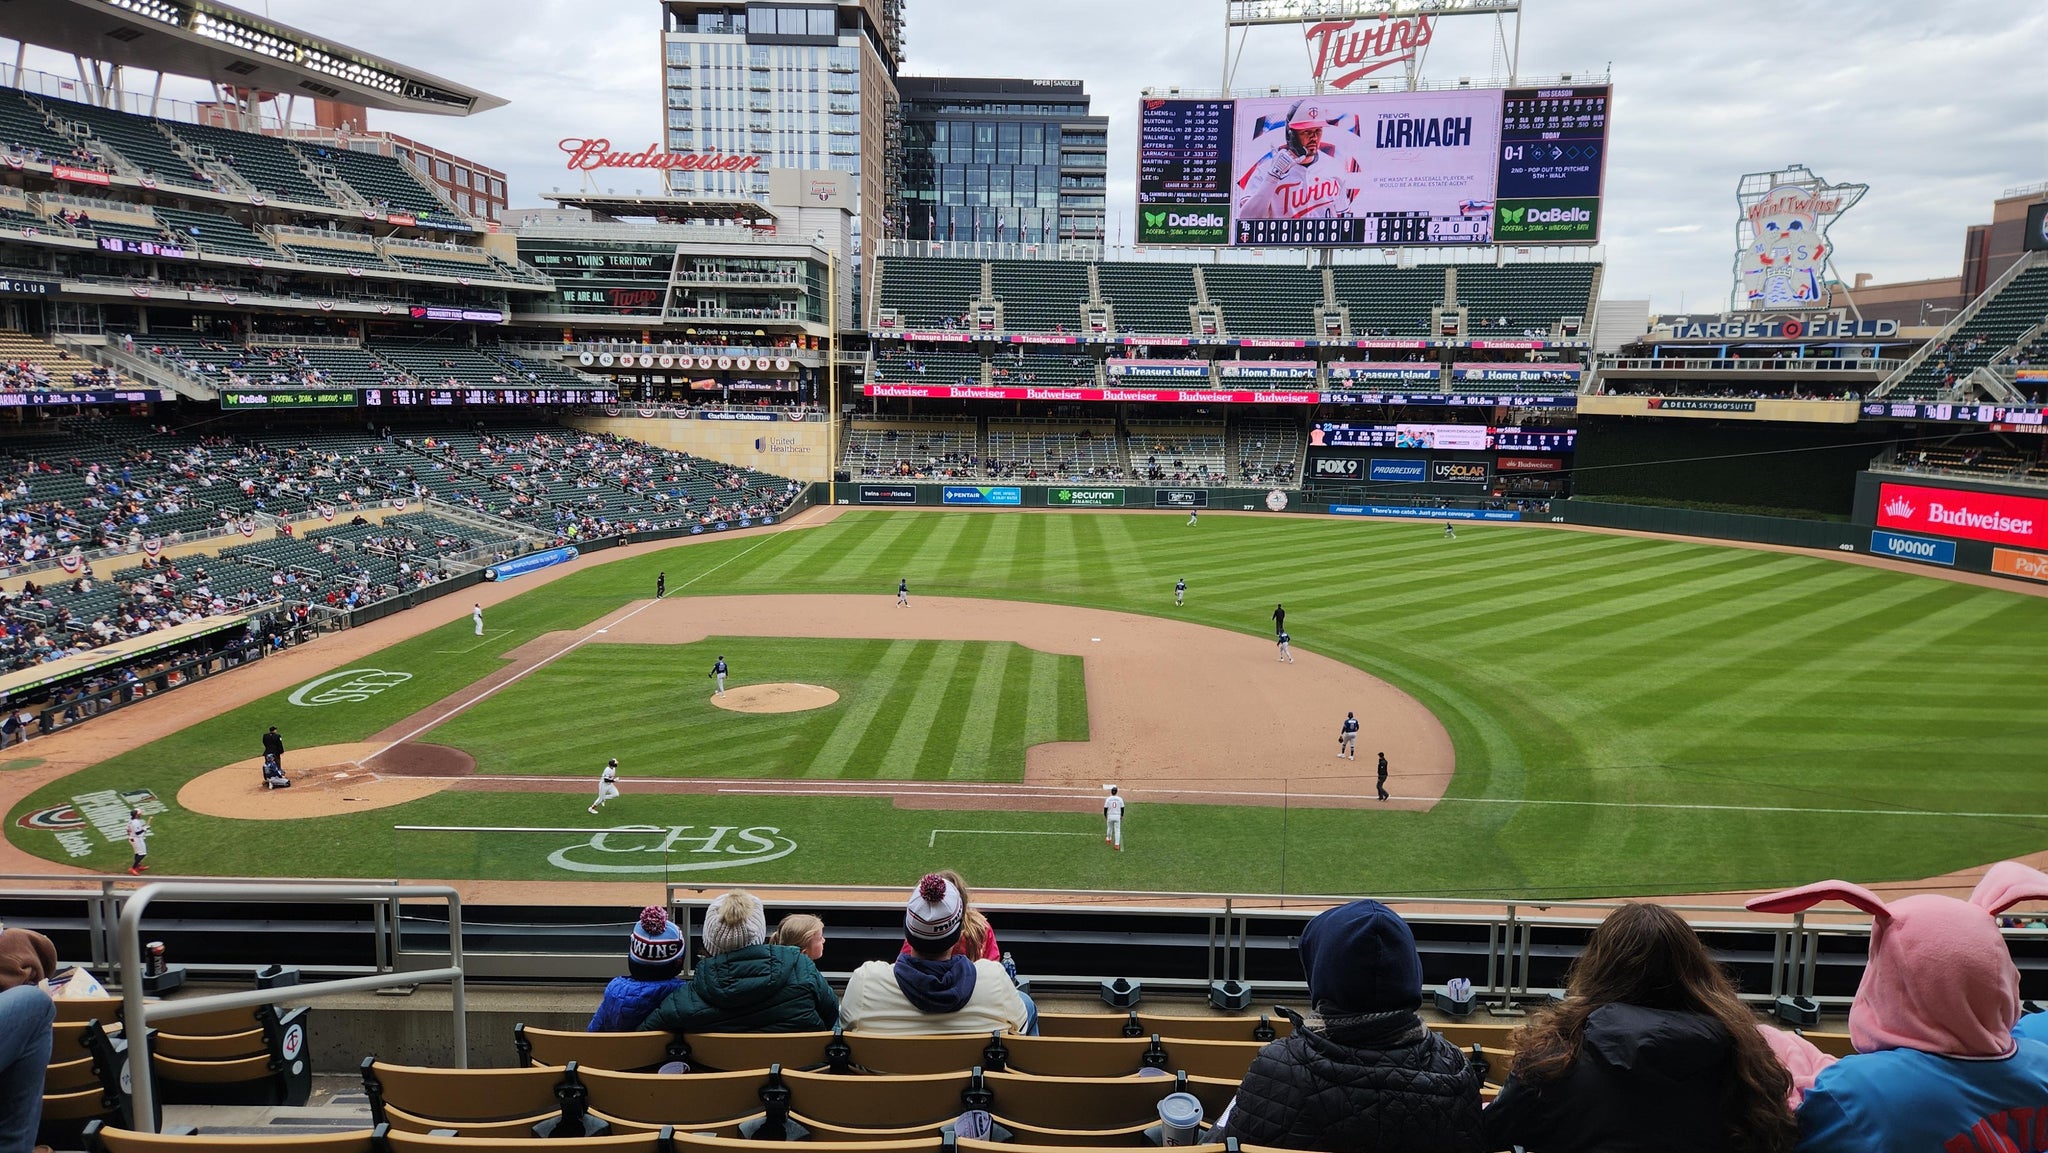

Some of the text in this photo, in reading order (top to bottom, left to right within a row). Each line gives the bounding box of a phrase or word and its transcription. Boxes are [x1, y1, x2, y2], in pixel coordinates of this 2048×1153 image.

[1306, 13, 1433, 83] Twins
[1376, 116, 1472, 149] LARNACH
[559, 138, 761, 171] Budweiser
[1504, 145, 1523, 160] 0-1
[1275, 177, 1339, 216] Twins
[1748, 191, 1842, 220] Win! Twins!
[1168, 213, 1224, 227] DaBella
[1527, 207, 1590, 223] DaBella
[1433, 223, 1479, 234] 2 0 0
[534, 255, 560, 264] WELCOME
[576, 255, 605, 266] TWINS
[609, 256, 653, 266] TERRITORY
[14, 282, 45, 294] CLUB
[563, 288, 657, 314] WE ARE ALL Twins
[1673, 320, 1897, 338] TARGET FIELD
[911, 333, 963, 342] Treasure Island
[1130, 337, 1182, 346] Treasure Island
[1364, 340, 1420, 348] Treasure Island
[720, 359, 728, 367] 14
[780, 360, 785, 368] 3
[1130, 367, 1201, 377] Treasure Island
[1241, 368, 1314, 378] Home Run Deck
[1356, 370, 1431, 379] Treasure Island
[1488, 370, 1520, 380] Home
[1521, 370, 1541, 380] Run
[239, 394, 268, 404] DaBella
[873, 385, 929, 397] Budweiser
[950, 387, 1006, 399] Budweiser
[1026, 389, 1082, 400] Budweiser
[1103, 390, 1158, 401] Budweiser
[1178, 391, 1233, 402] Budweiser
[1254, 392, 1309, 403] Budweiser
[1332, 394, 1348, 402] 95.9
[366, 398, 381, 406] MLB
[1466, 397, 1485, 405] 101.8
[1670, 401, 1697, 409] DELTA
[1730, 402, 1753, 411] SUITE
[735, 413, 771, 421] Clubhouse
[1323, 423, 1333, 431] 22
[770, 437, 795, 445] United
[770, 444, 811, 453] Healthcare
[1316, 459, 1358, 474] FOX 9
[1517, 460, 1554, 469] Budweiser
[1373, 466, 1423, 475] PROGRESSIVE
[1449, 465, 1485, 477] SOLAR
[1071, 490, 1115, 500] securian
[1371, 507, 1393, 515] There's
[1401, 508, 1418, 516] catch.
[1418, 509, 1432, 517] Just
[1432, 510, 1447, 518] great
[1447, 511, 1476, 519] coverage.
[1928, 502, 2033, 535] Budweiser
[1888, 537, 1937, 557] uponor
[310, 672, 413, 702] CHS
[589, 824, 781, 854] CHS
